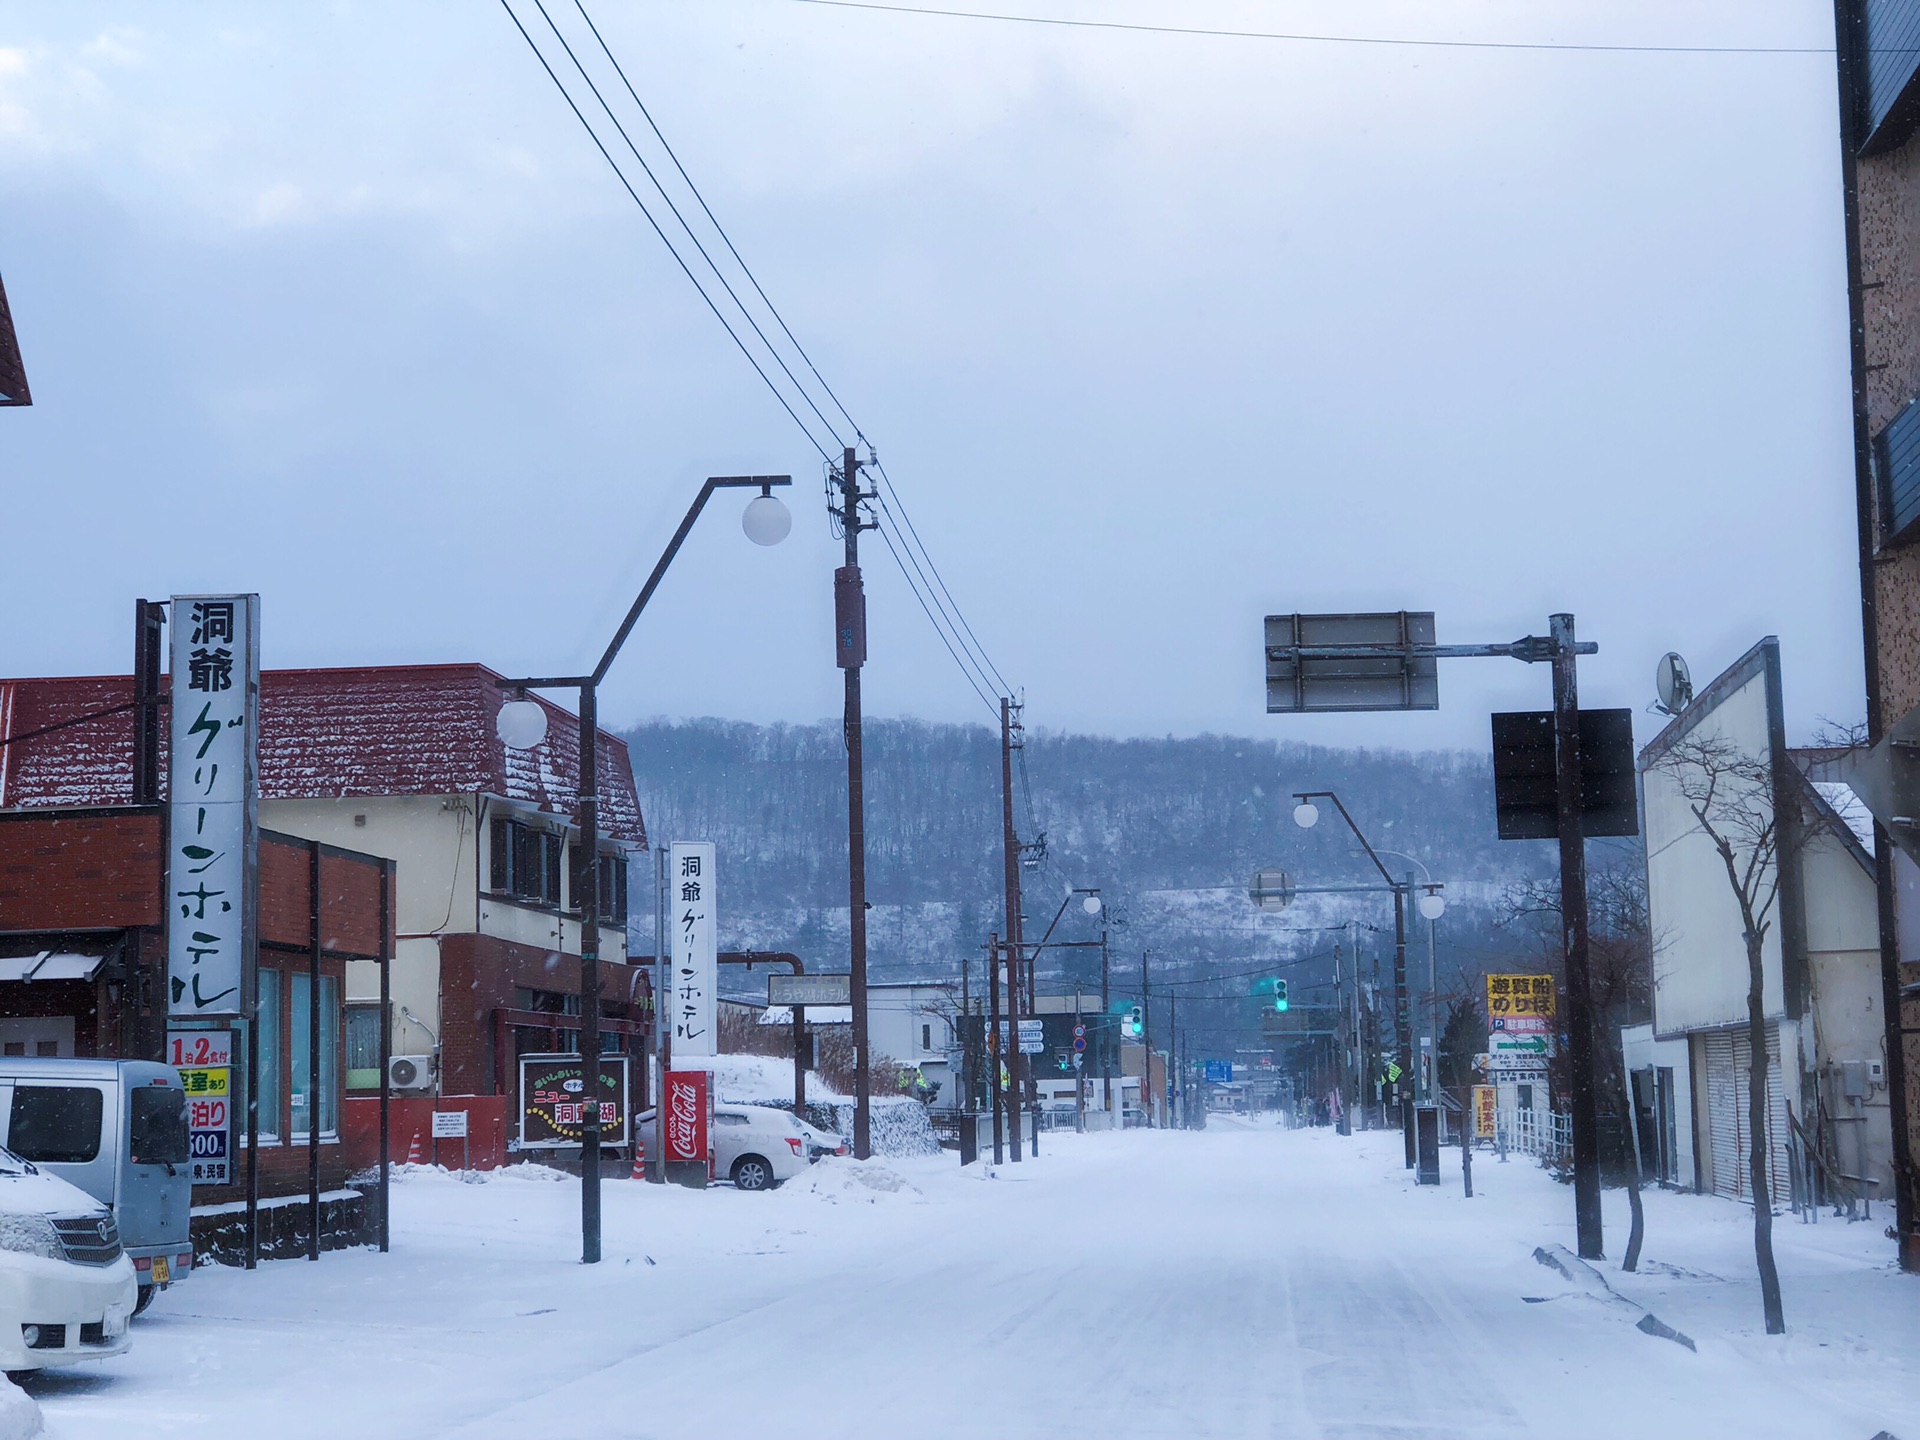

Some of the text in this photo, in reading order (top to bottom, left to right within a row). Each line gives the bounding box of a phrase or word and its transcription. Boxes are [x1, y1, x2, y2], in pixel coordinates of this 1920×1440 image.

[172, 602, 243, 1009] 洞爺グリーンホテル
[678, 856, 706, 1040] 洞爺グリーンホテル
[1492, 977, 1550, 995] 遊覧船
[172, 1037, 228, 1066] 1泊2食付
[533, 1090, 570, 1104] ニュー
